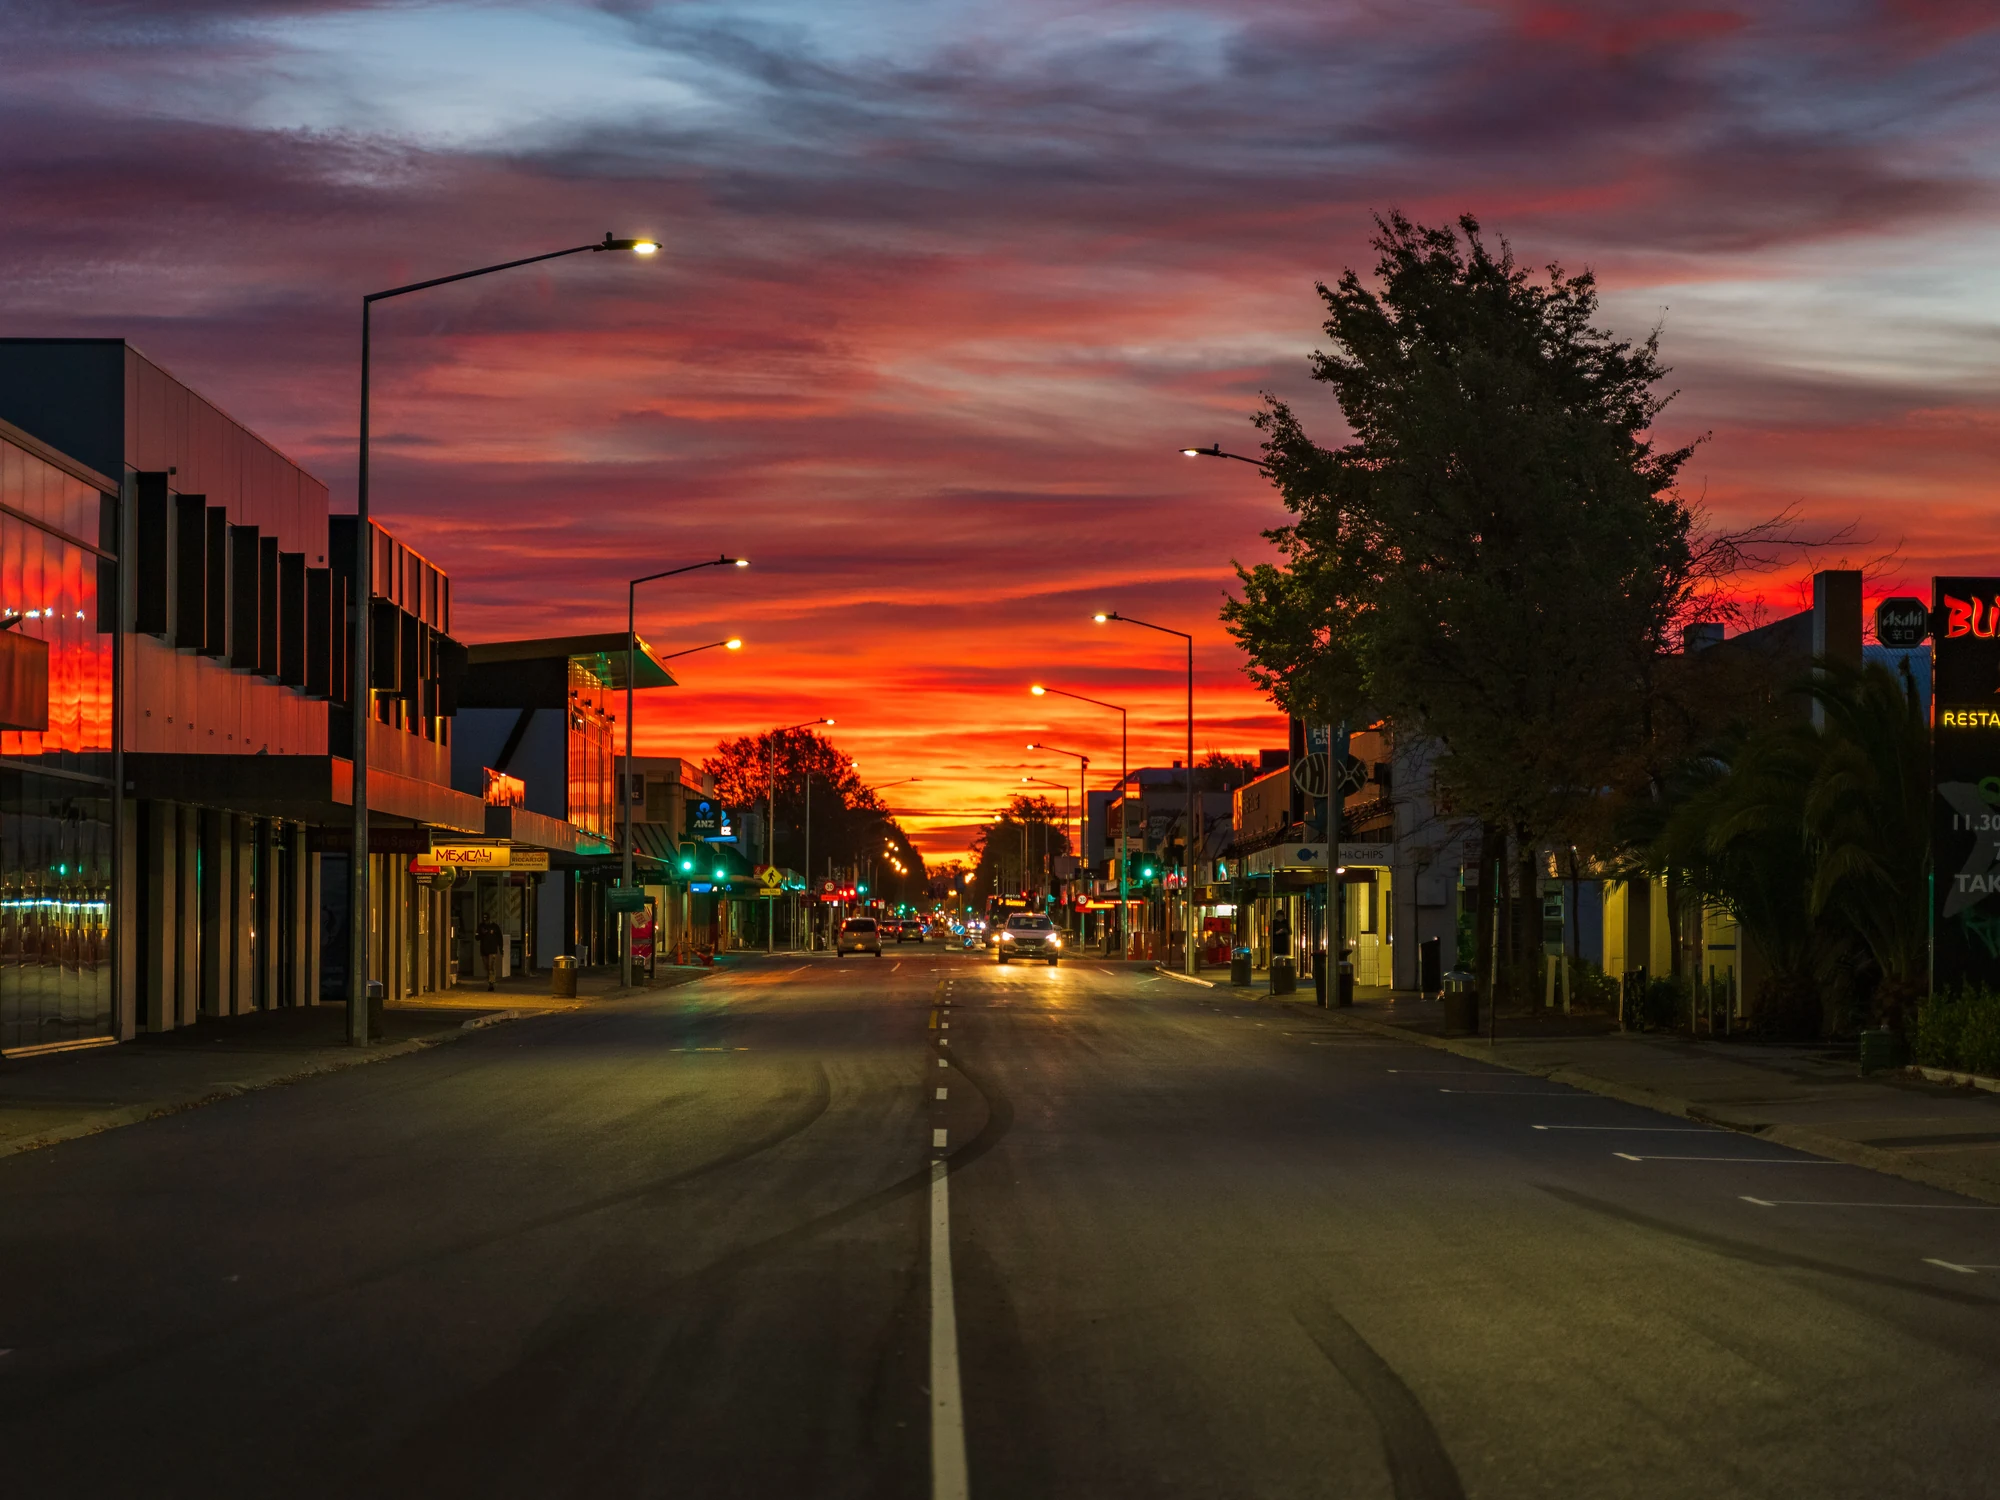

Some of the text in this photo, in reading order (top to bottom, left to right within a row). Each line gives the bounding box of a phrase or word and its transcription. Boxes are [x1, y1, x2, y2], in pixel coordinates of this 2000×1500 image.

[1883, 610, 1922, 626] Asahi
[1944, 593, 2000, 638] BU
[1944, 713, 2000, 727] RESTA
[693, 820, 715, 828] ANZ
[436, 848, 492, 862] MEXICALI
